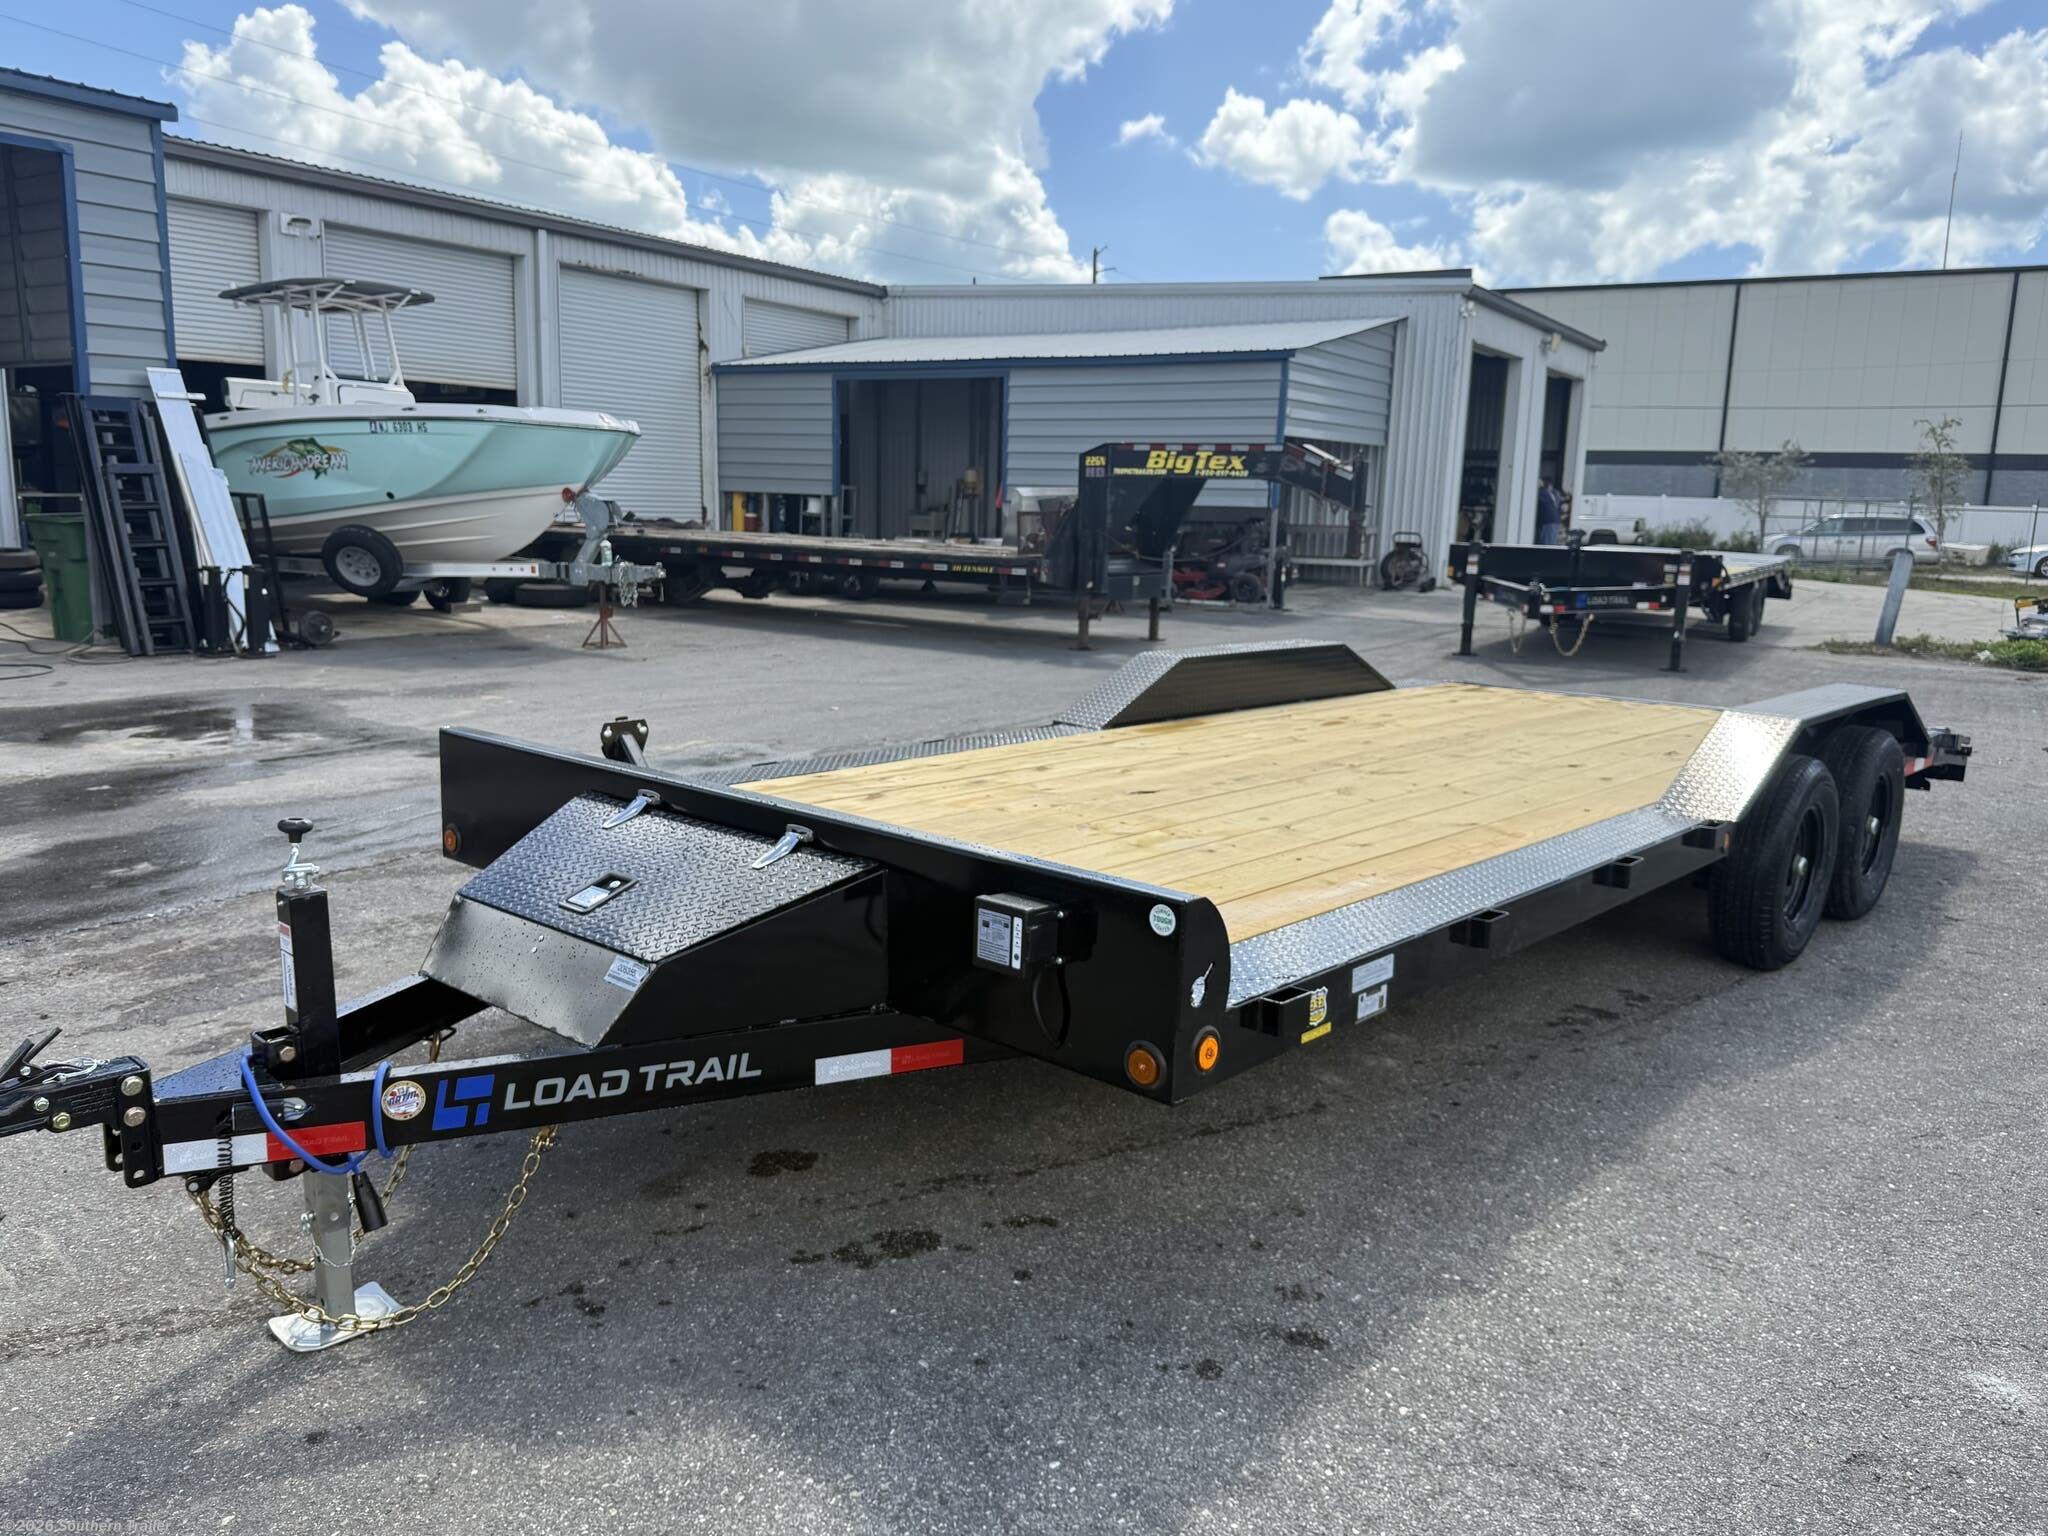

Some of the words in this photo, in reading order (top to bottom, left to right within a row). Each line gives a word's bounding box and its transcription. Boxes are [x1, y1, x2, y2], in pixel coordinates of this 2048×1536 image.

[306, 453, 349, 472] DREAM
[503, 1068, 631, 1111] LOAD
[639, 1052, 762, 1092] TRAIL
